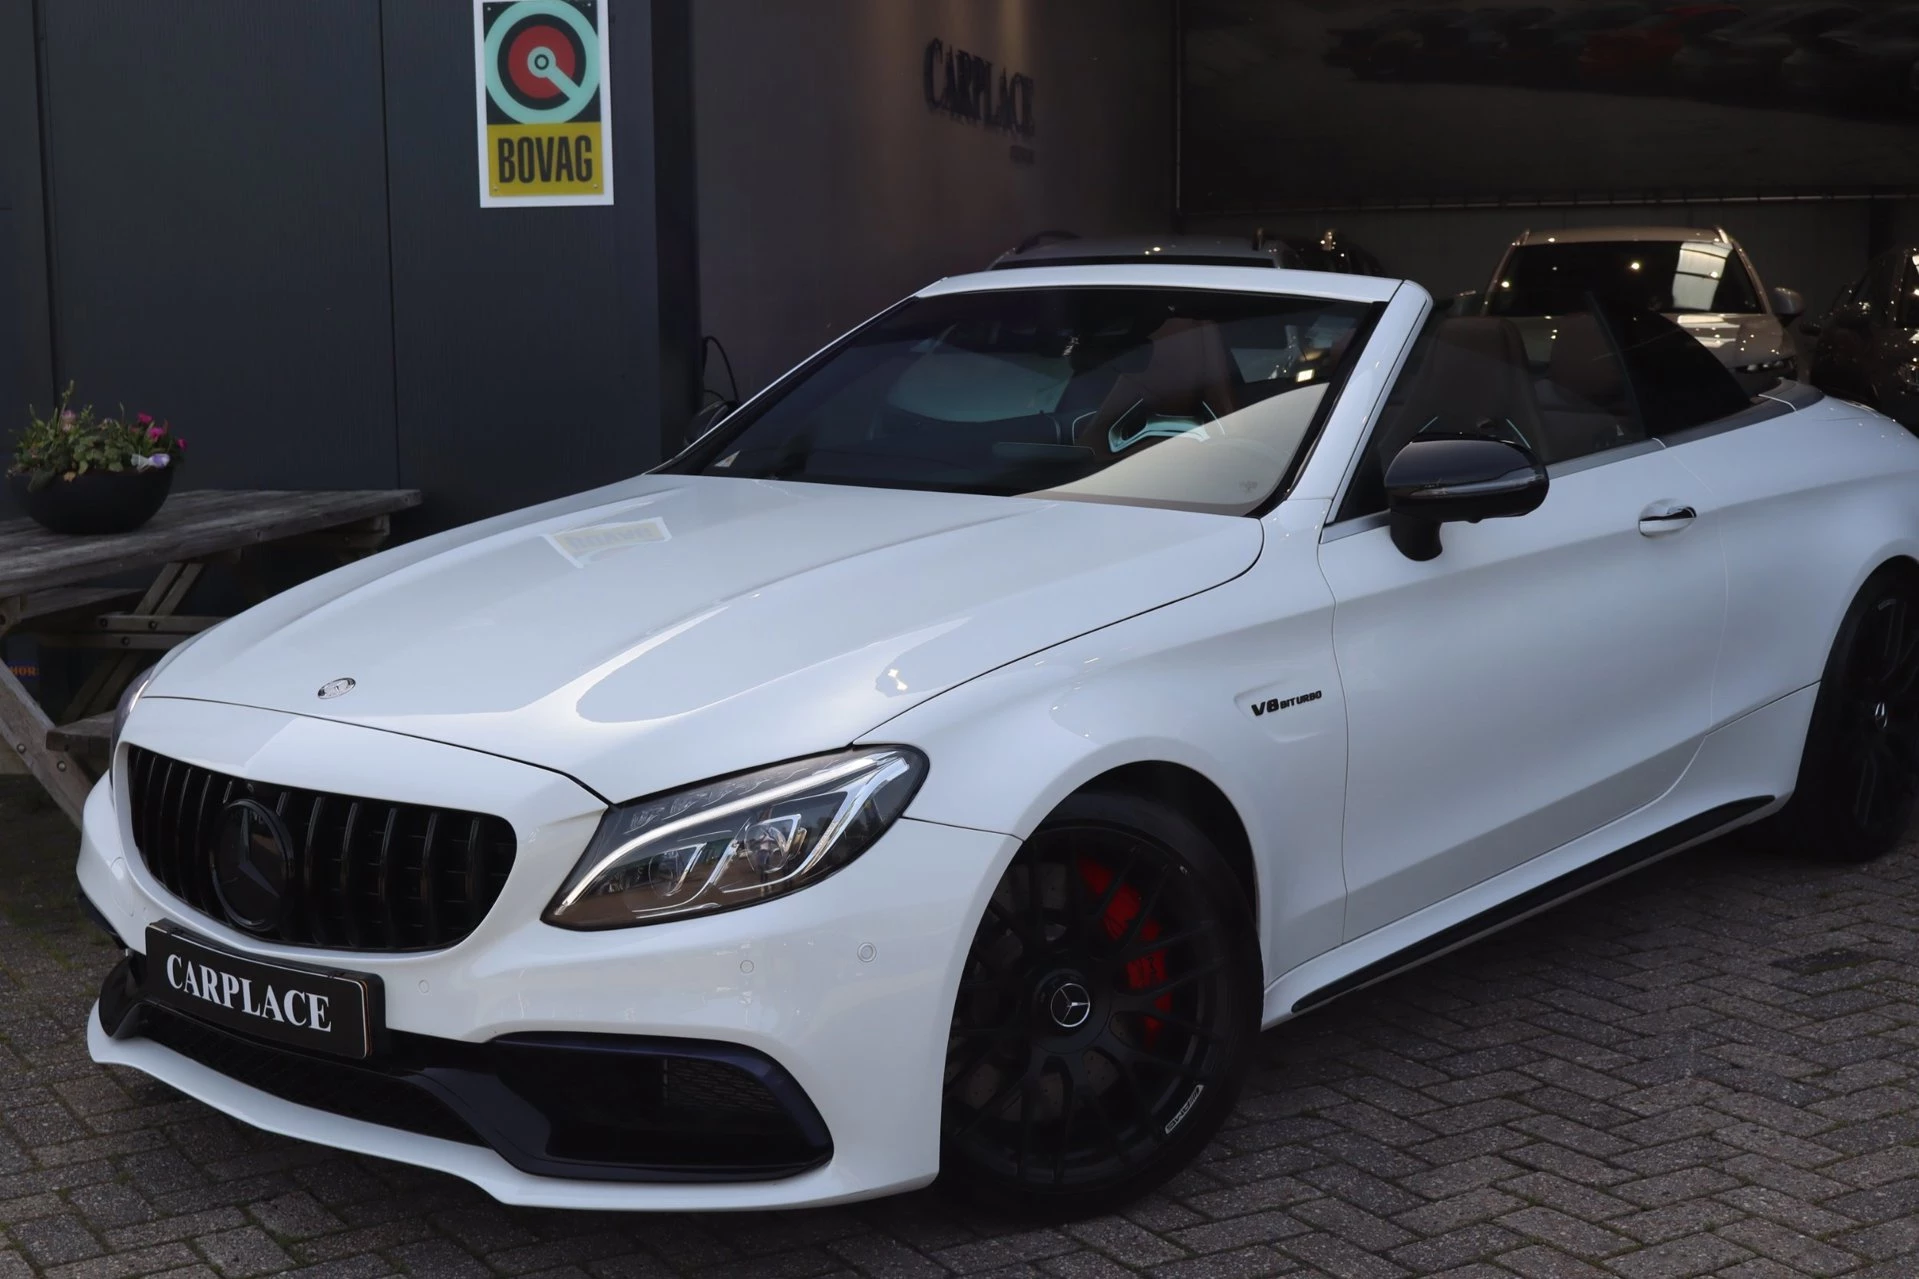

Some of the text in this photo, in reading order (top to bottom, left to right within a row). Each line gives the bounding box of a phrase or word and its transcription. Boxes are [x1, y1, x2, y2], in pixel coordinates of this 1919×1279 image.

[497, 134, 593, 183] BOVAG
[1251, 690, 1322, 716] V8 BITURBO
[166, 953, 332, 1033] CARPLACE
